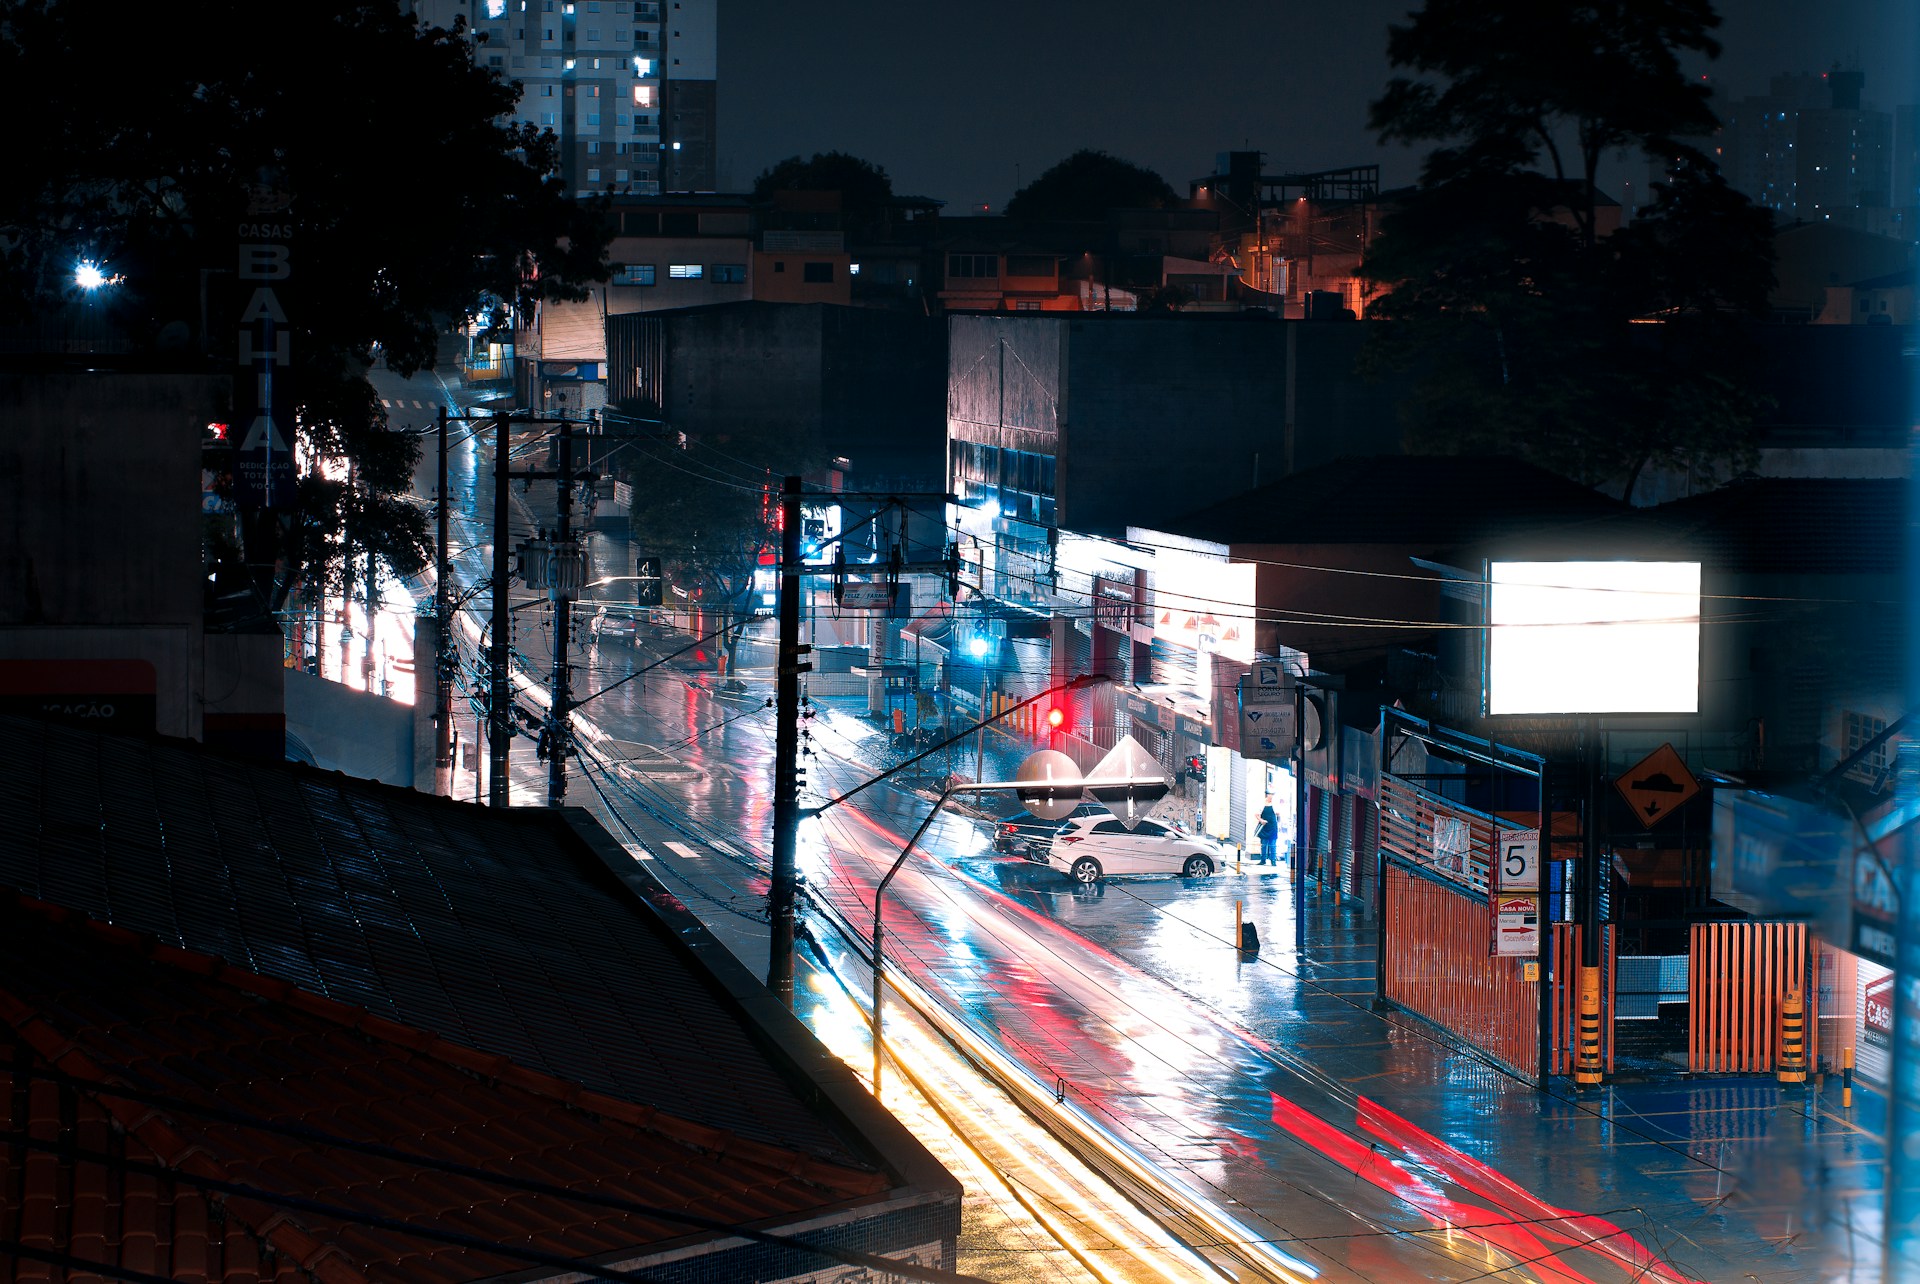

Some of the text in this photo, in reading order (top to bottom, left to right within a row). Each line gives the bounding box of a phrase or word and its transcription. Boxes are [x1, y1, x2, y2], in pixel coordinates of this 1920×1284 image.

[238, 223, 293, 238] CASAS
[238, 244, 292, 451] BAHIA
[873, 621, 884, 664] Drogaria
[1505, 845, 1526, 877] 5
